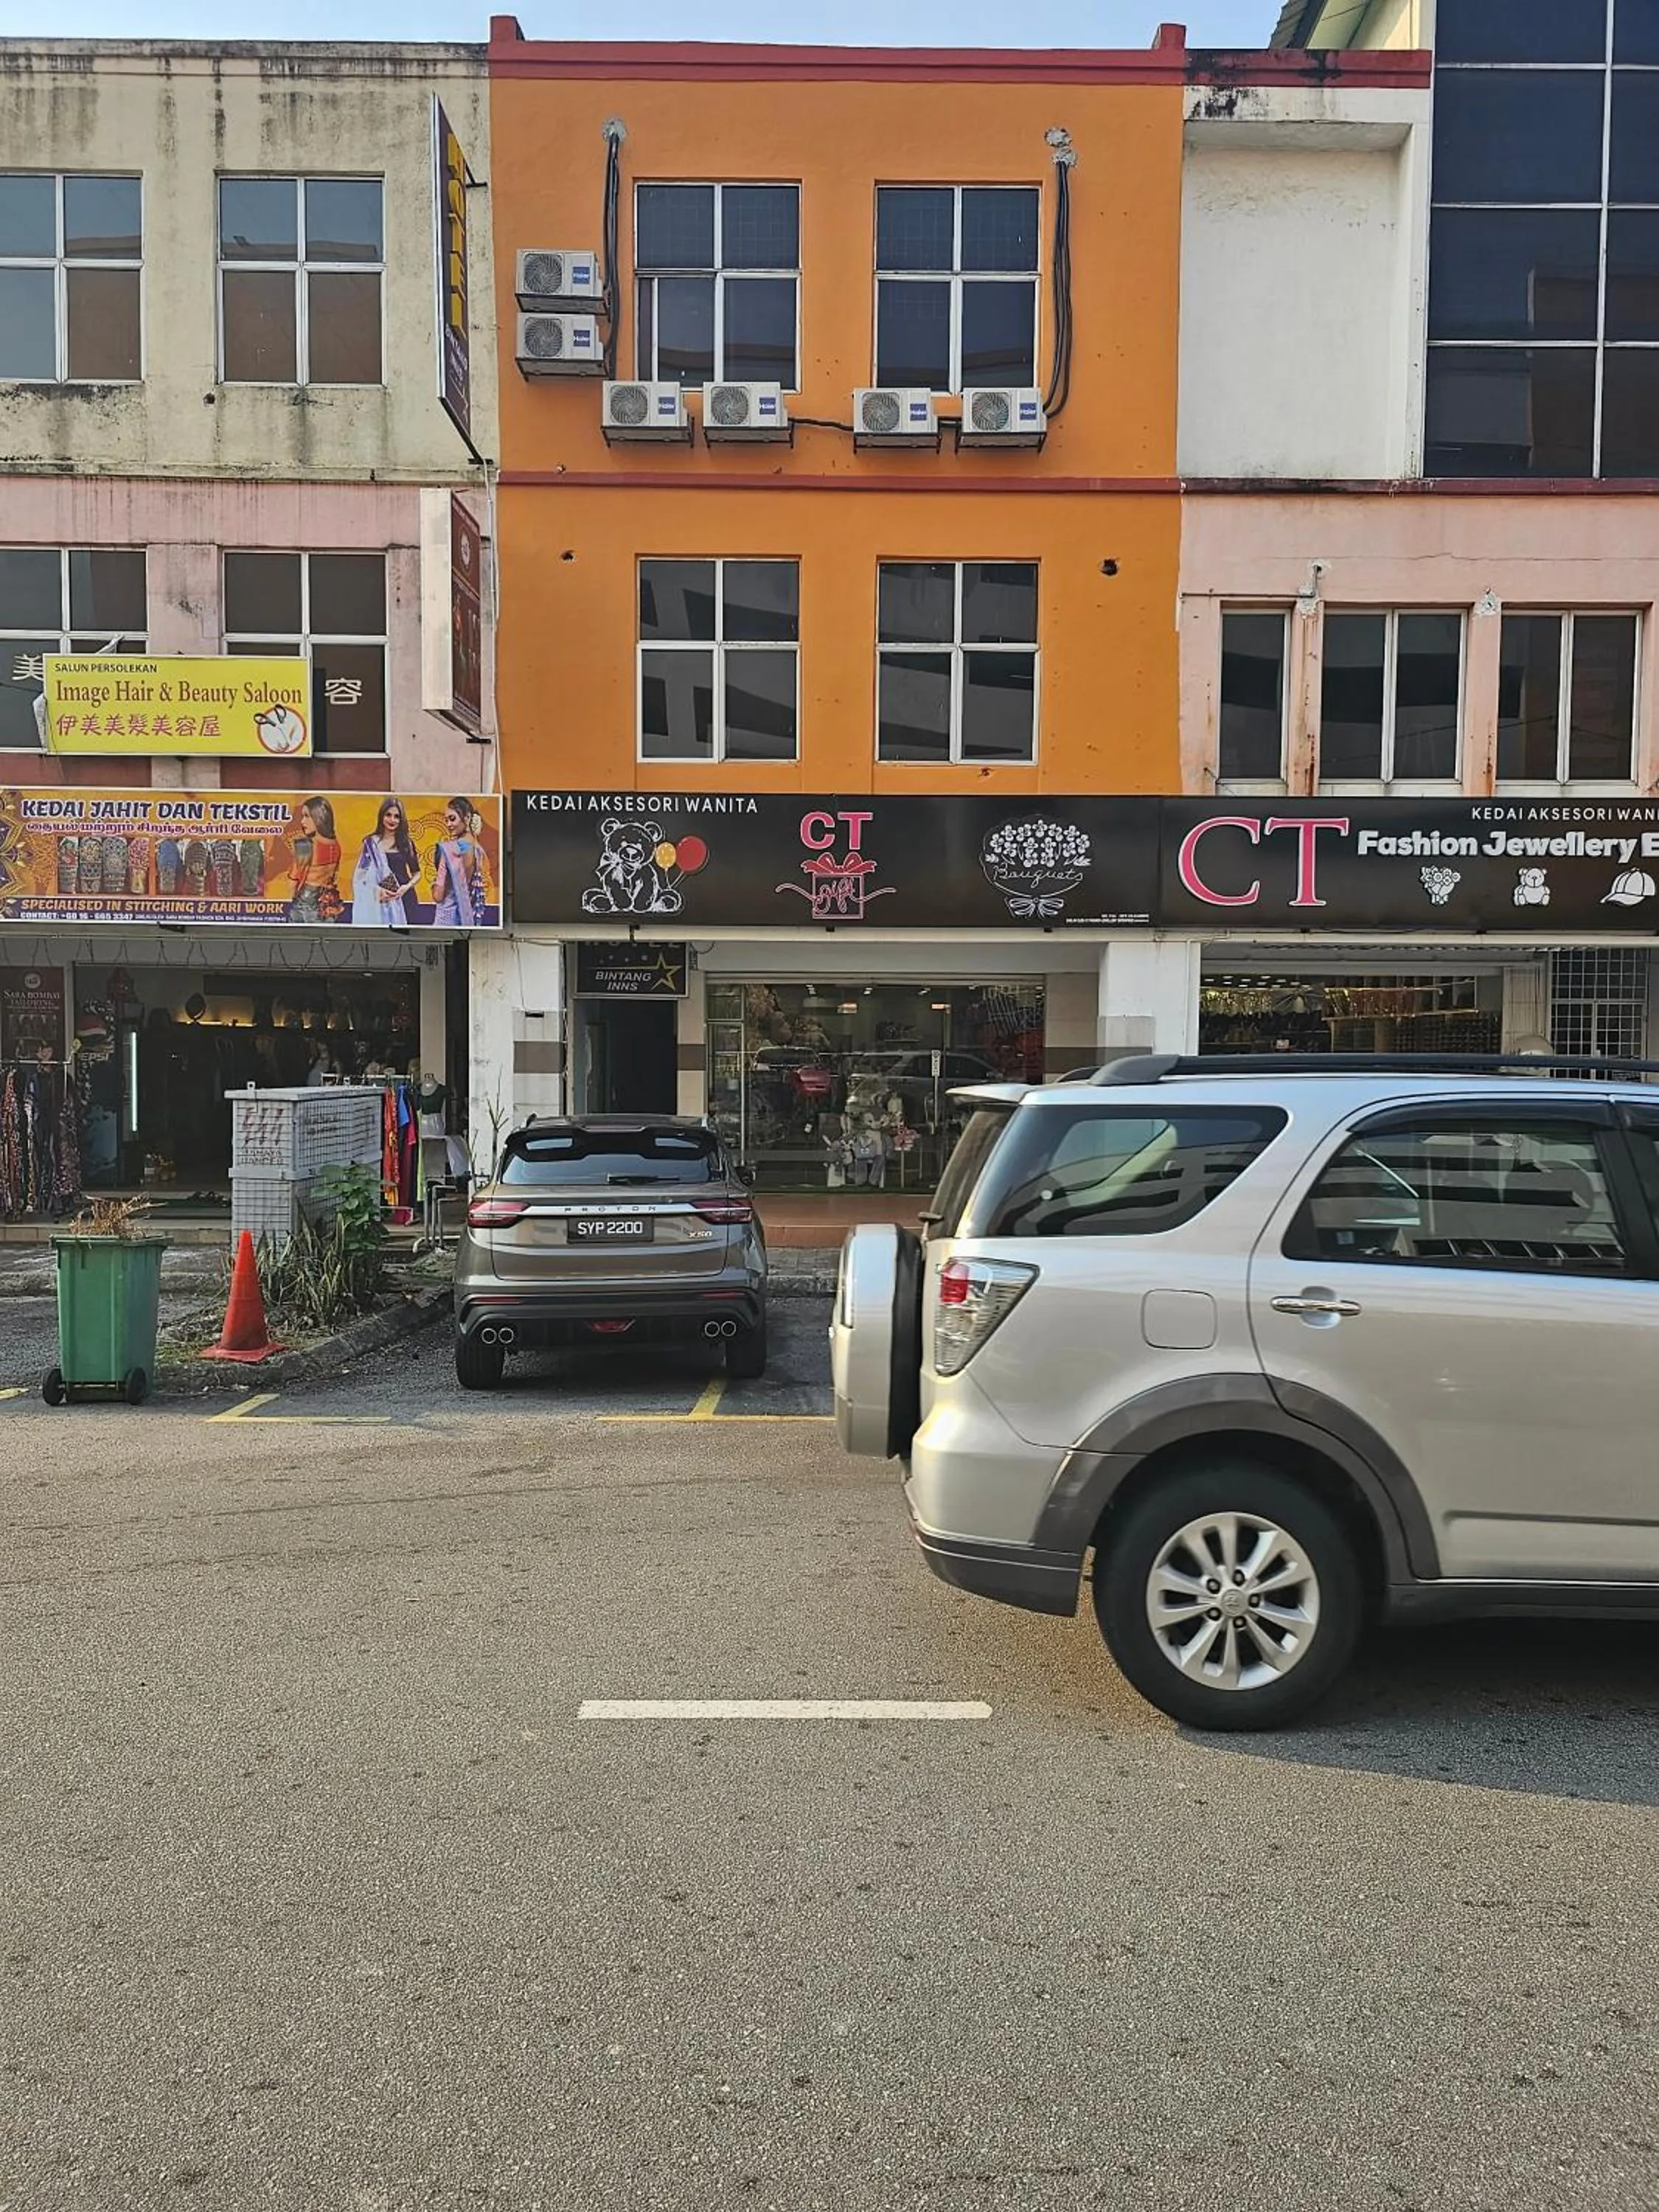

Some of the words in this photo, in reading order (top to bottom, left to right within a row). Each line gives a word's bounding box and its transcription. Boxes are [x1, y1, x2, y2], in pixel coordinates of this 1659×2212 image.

[55, 663, 88, 672] SALUN
[91, 664, 157, 673] PERSOLEKAN
[57, 681, 110, 708] Image
[116, 681, 154, 701] Hair
[159, 683, 173, 701] &
[179, 681, 237, 709] Beauty
[244, 683, 302, 704] Saloon
[324, 678, 362, 705] 容
[57, 713, 221, 737] 伊美美髮美容屋
[22, 800, 85, 817] KEDAI
[91, 801, 152, 818] JAHIT
[158, 802, 204, 820] DAN
[209, 804, 292, 821] TEKSTIL
[526, 795, 582, 811] KEDAI
[588, 796, 679, 812] AKSESORI
[685, 797, 758, 813] WANITA
[1472, 807, 1523, 820] KEDAI
[1528, 807, 1612, 821] AKSESORI
[800, 811, 873, 850] CT
[1357, 830, 1478, 856] Fashion
[1482, 831, 1638, 863] Jewellery
[1641, 832, 1659, 857] E
[1178, 816, 1349, 906] CT
[813, 876, 855, 914] gift
[21, 899, 102, 911] SPECIALISED
[107, 900, 121, 911] IN
[125, 900, 194, 912] STITCHING
[197, 902, 206, 913] &
[210, 902, 240, 913] AARI
[245, 902, 284, 914] WORK
[595, 971, 651, 981] BINTANG
[607, 982, 639, 991] INNS
[577, 1222, 604, 1235] SYP
[607, 1222, 643, 1234] 2200
